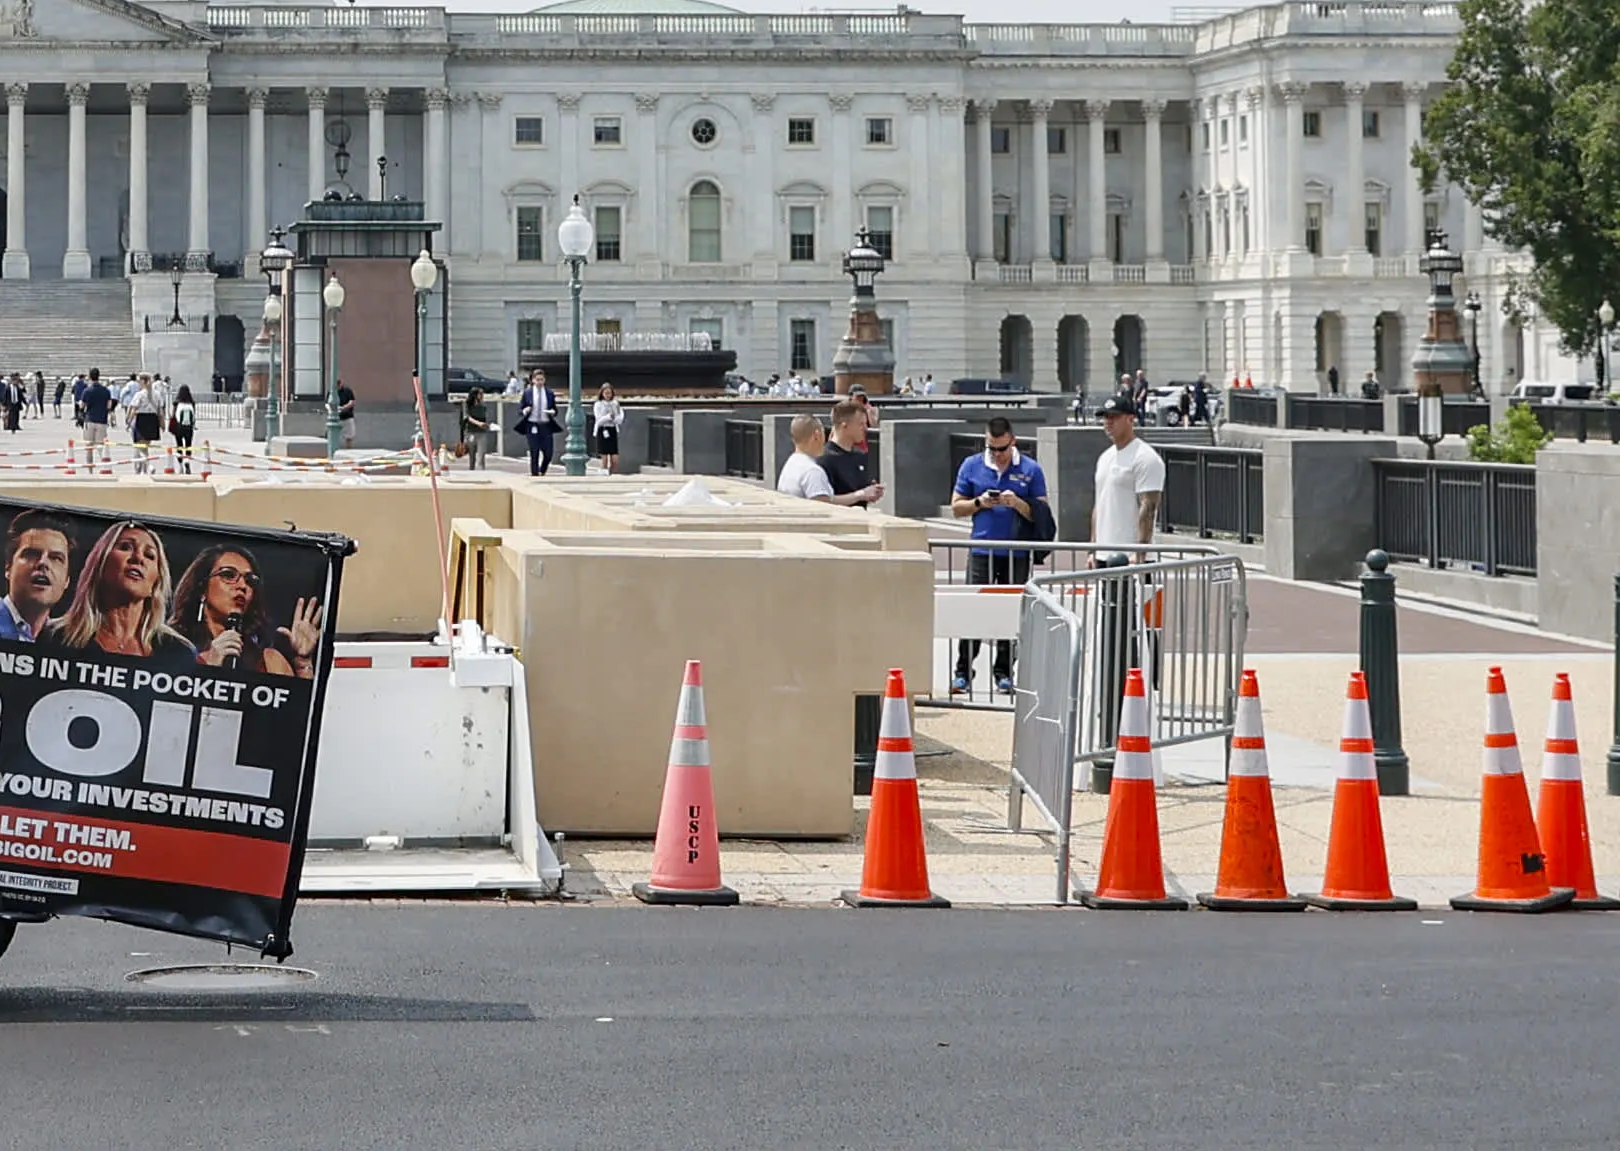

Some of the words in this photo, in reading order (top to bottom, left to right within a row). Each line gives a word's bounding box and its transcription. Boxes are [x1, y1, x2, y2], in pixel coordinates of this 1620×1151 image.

[39, 657, 69, 681] IN
[76, 661, 128, 688] THE
[133, 669, 246, 704] POCKET
[251, 685, 291, 709] OF
[25, 688, 274, 799] OIL
[78, 782, 285, 830] INVESTMENTS
[0, 814, 50, 840] LET
[54, 821, 137, 852] THEM.
[688, 805, 700, 864] USCP
